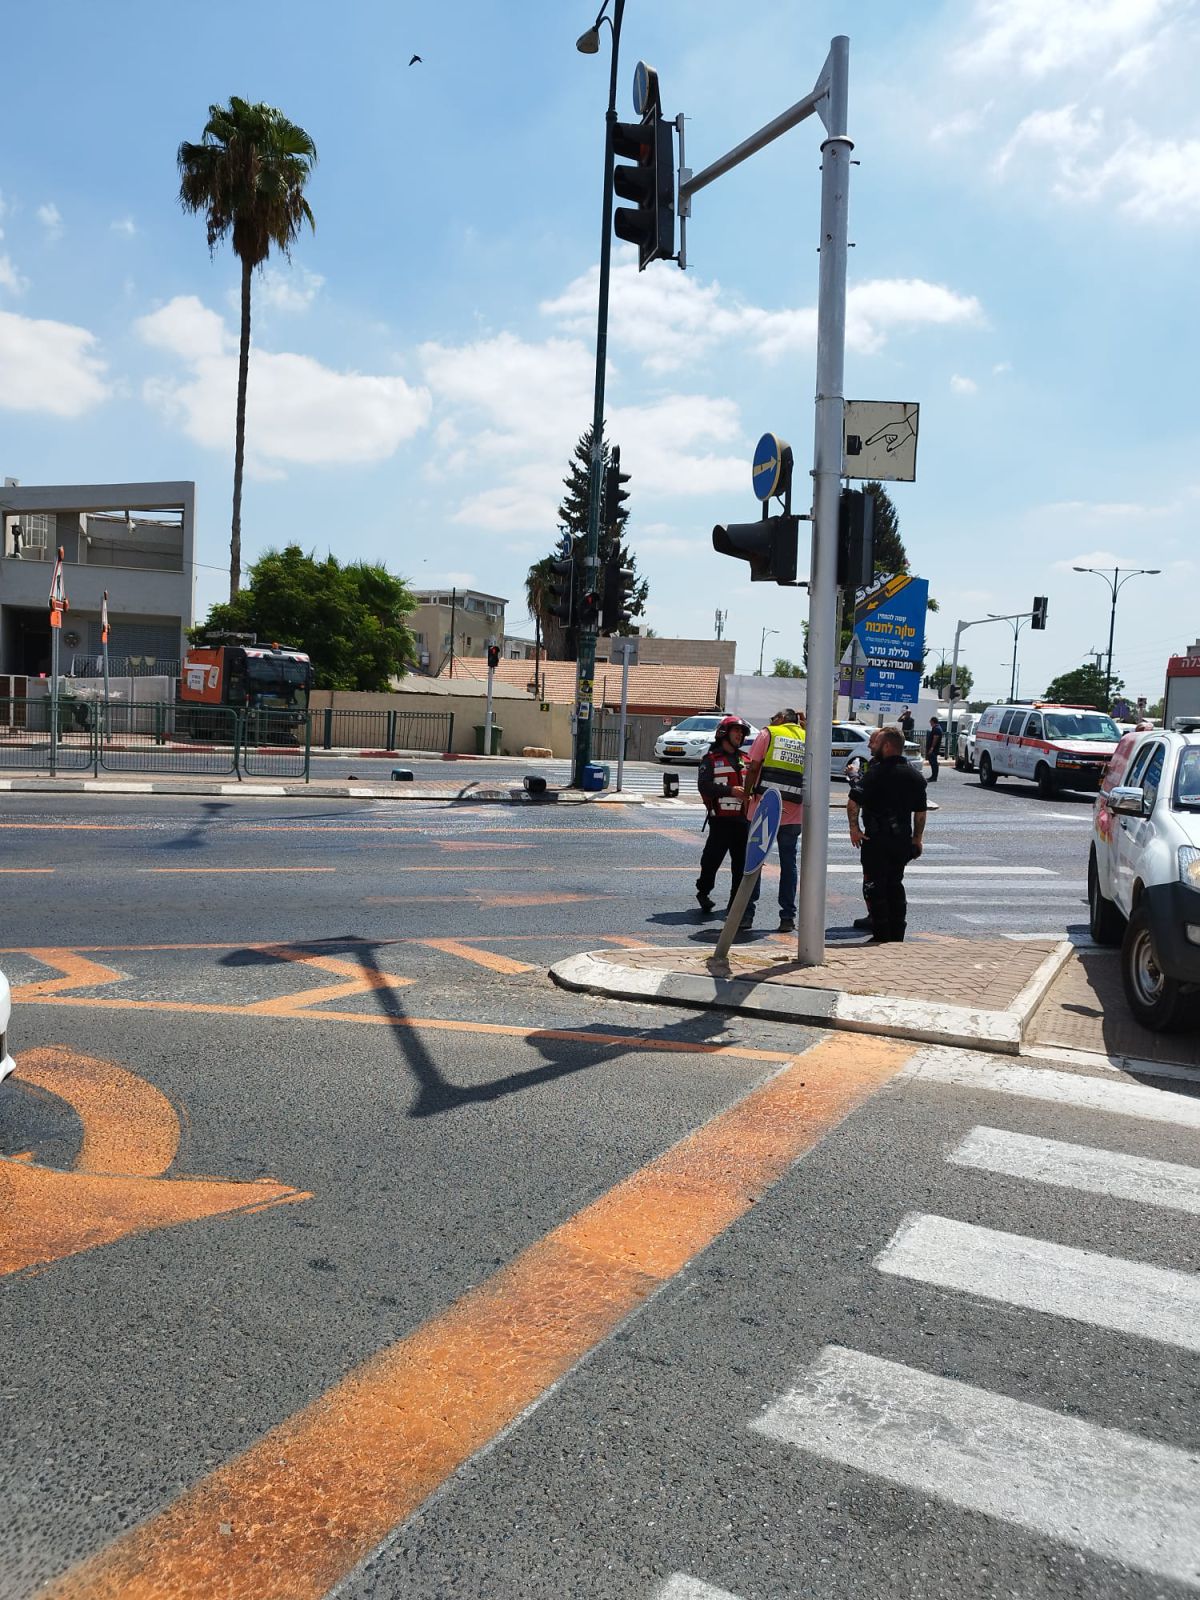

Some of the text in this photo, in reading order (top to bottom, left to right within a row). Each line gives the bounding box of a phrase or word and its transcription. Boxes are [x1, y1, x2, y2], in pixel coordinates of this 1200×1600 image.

[865, 622, 893, 634] לחכות
[870, 646, 910, 658] סלילת נתיב
[888, 660, 913, 670] תחבורה
[879, 671, 895, 679] חדש
